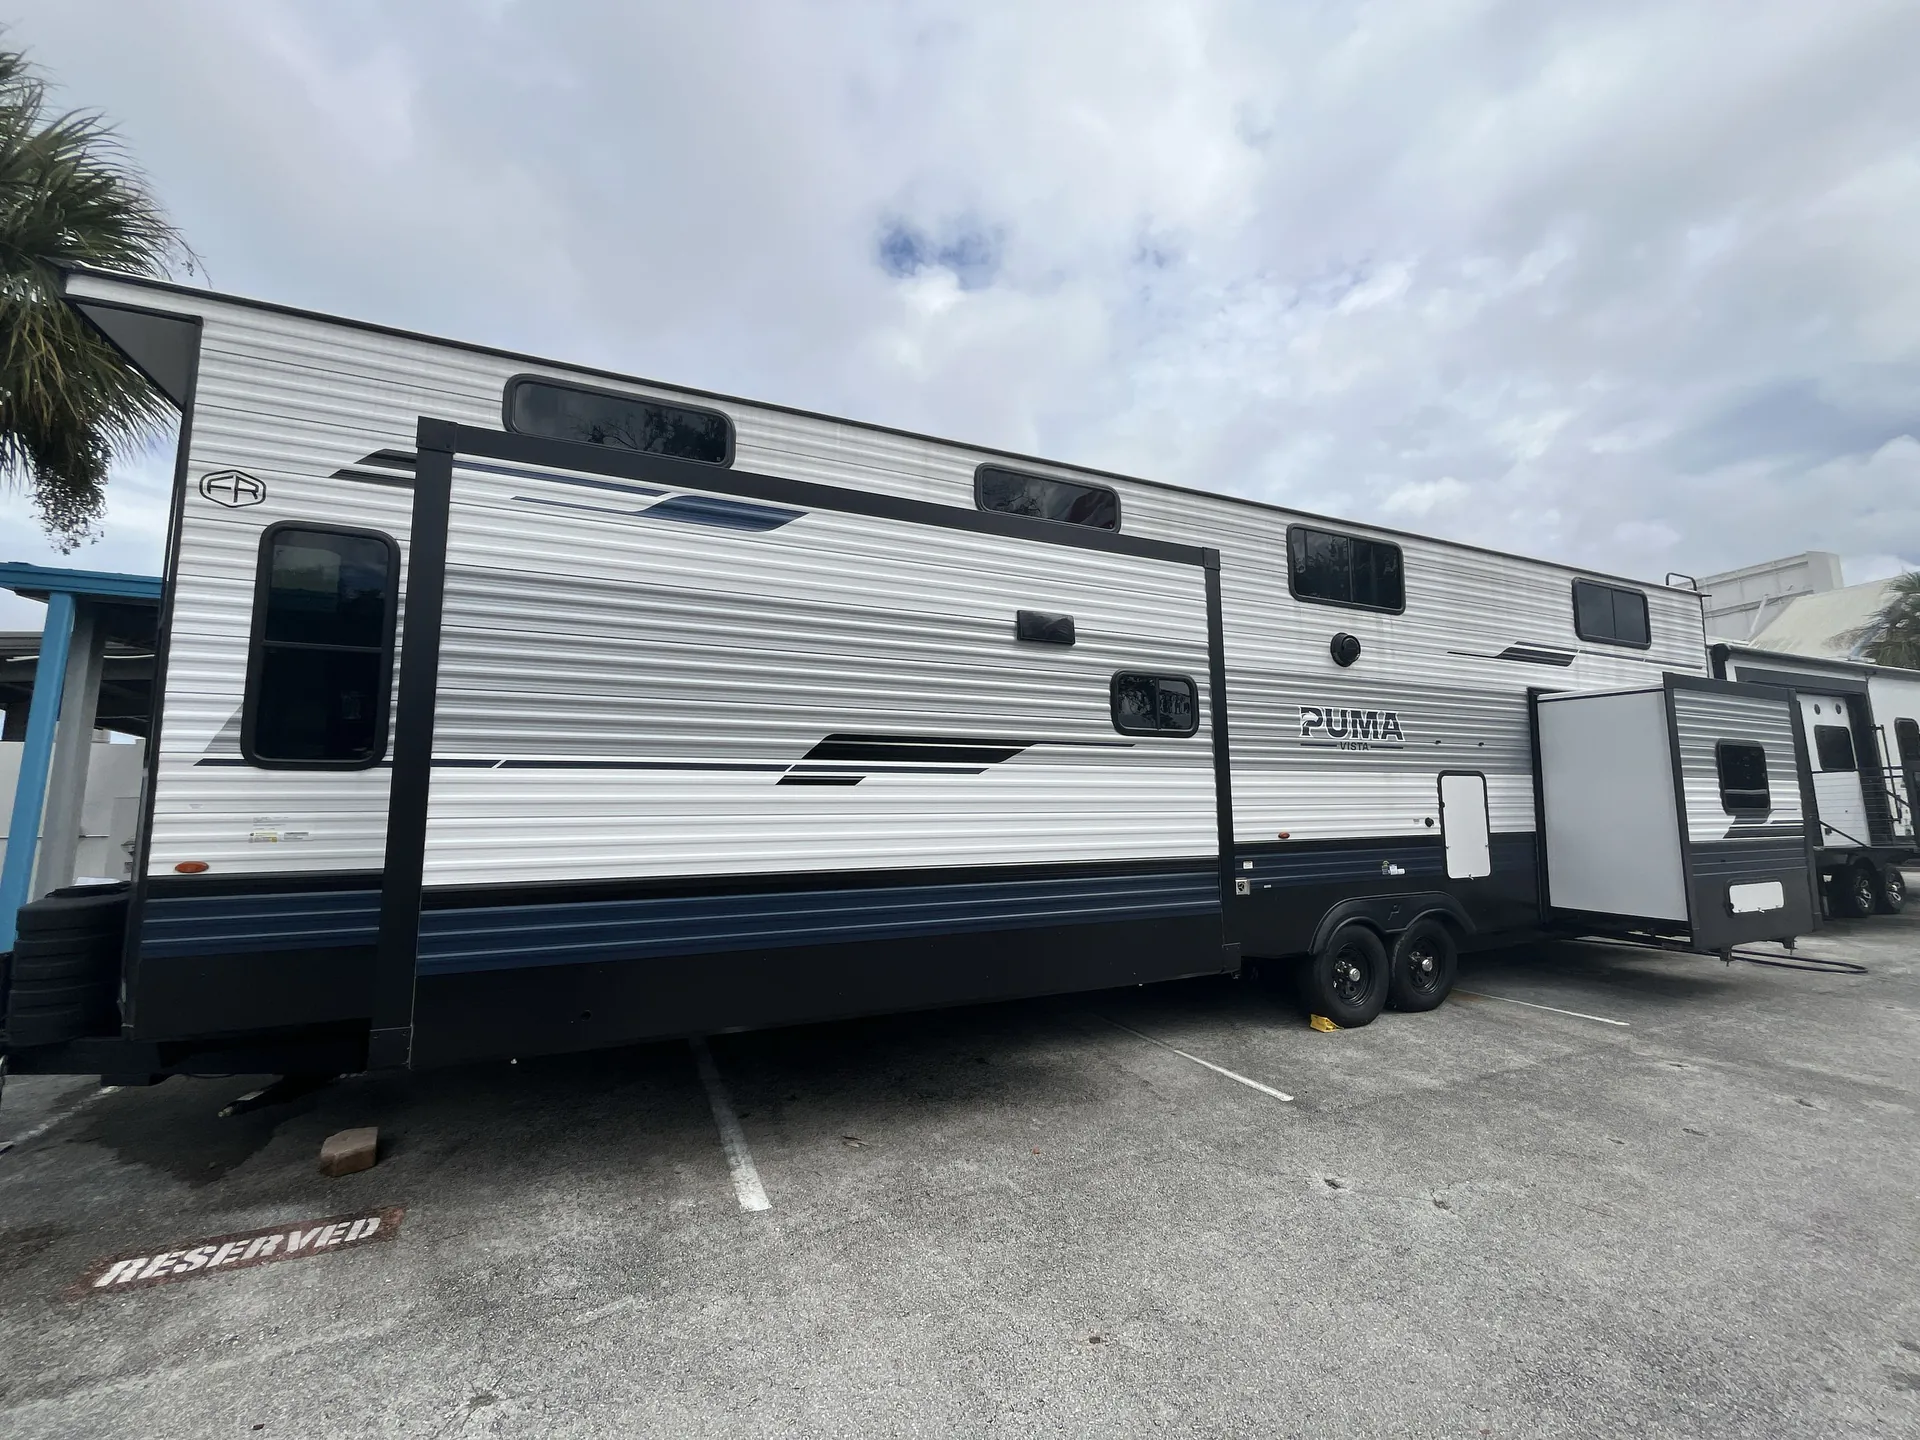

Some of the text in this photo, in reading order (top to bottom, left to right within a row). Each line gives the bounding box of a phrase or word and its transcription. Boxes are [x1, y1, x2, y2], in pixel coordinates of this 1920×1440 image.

[1300, 706, 1404, 740] PUMA
[1340, 742, 1369, 751] VISTA
[94, 1217, 381, 1288] RESERVED
